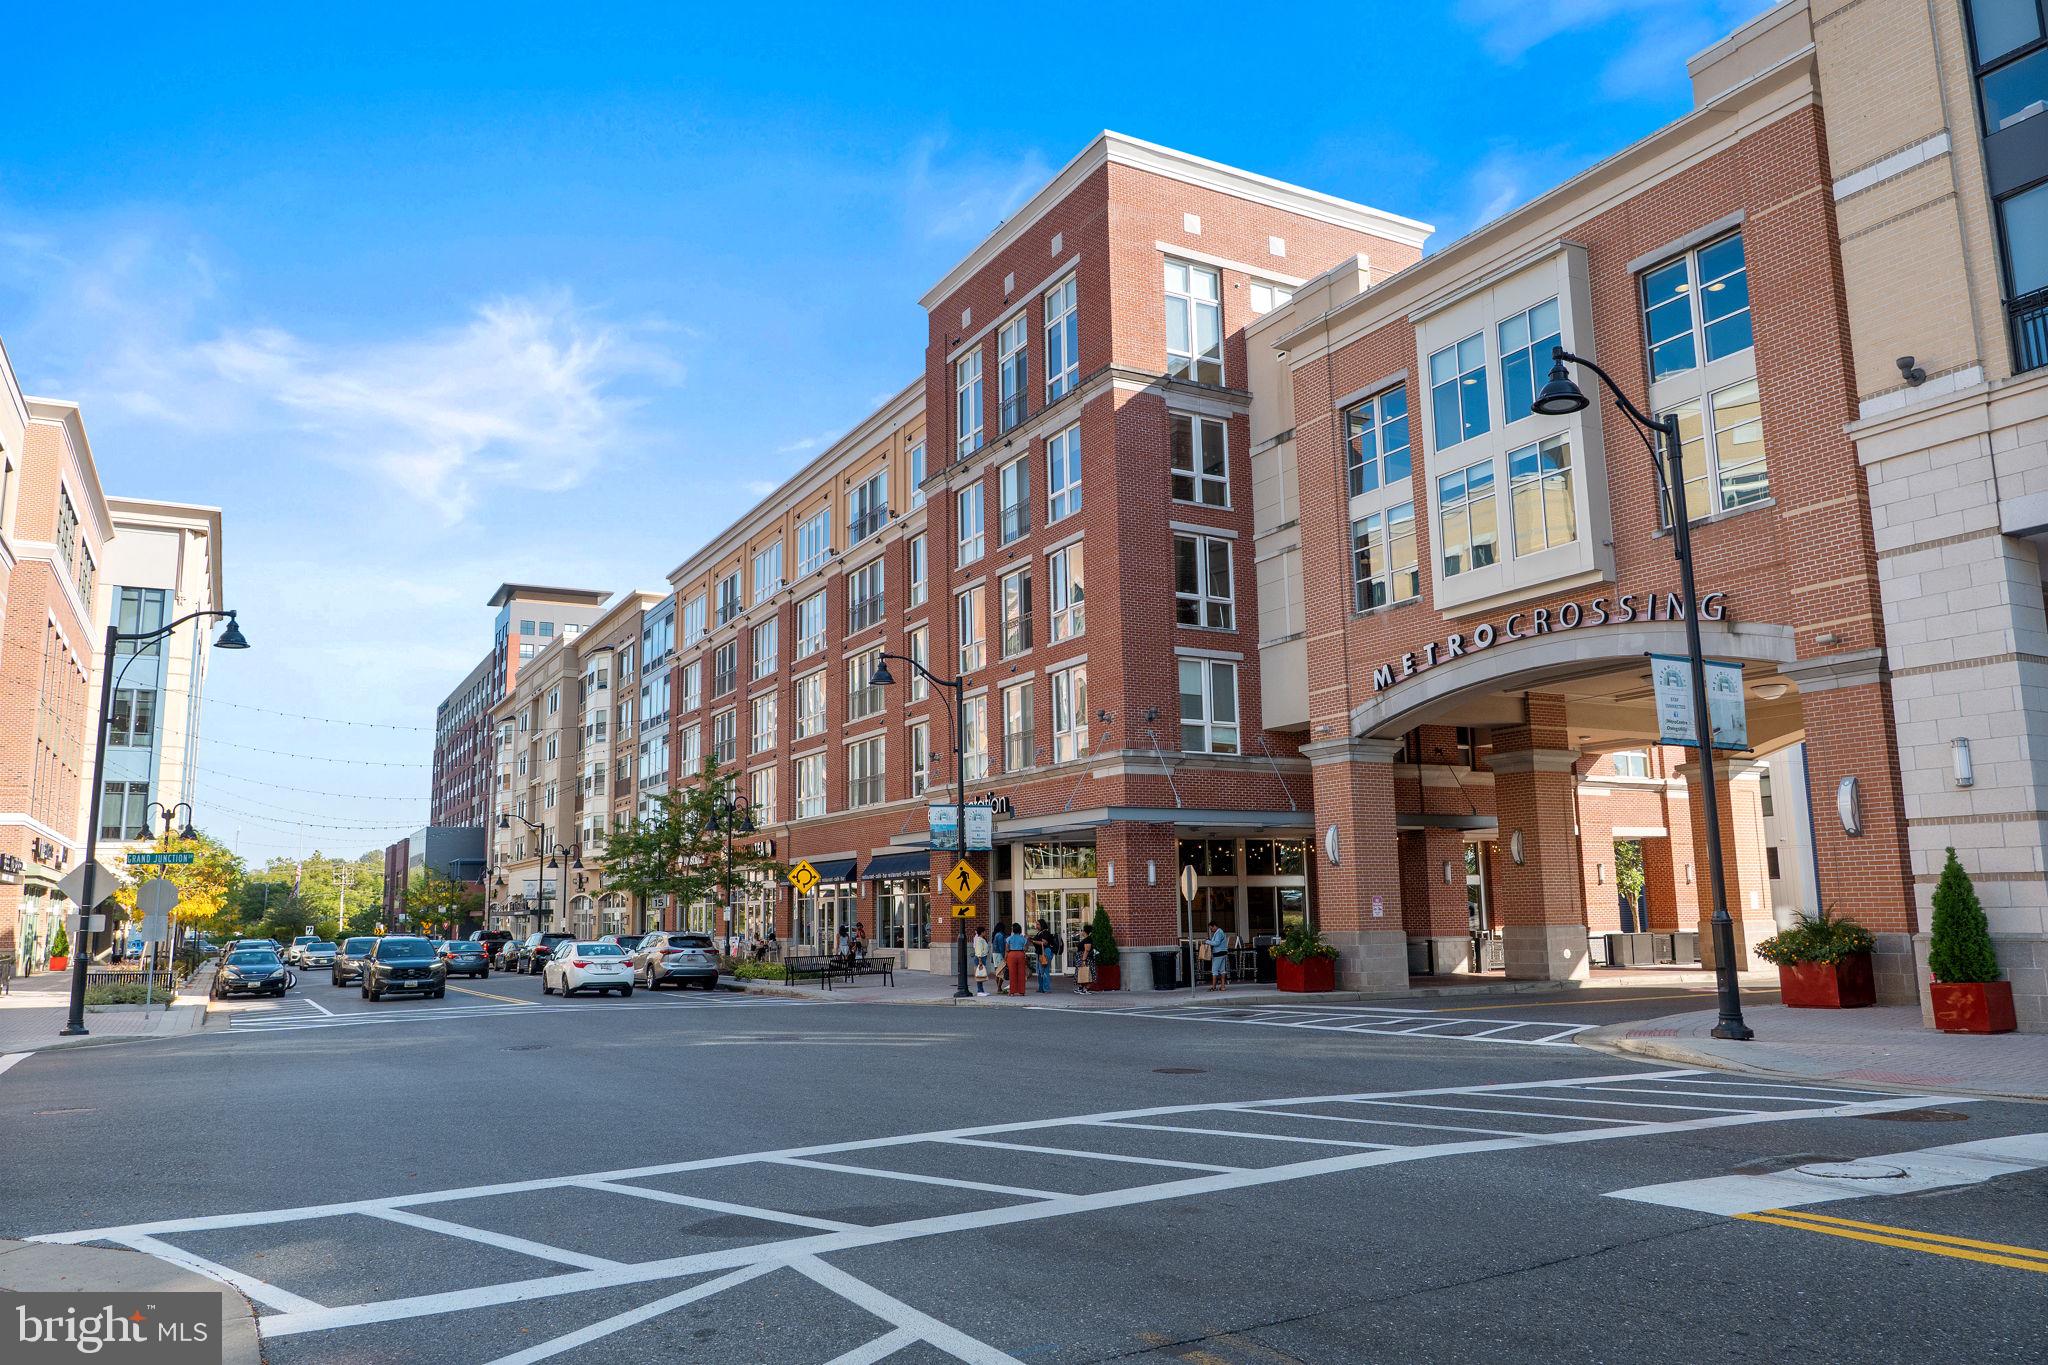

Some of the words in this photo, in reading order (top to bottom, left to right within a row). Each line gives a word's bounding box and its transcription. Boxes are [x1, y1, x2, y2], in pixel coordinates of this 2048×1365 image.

[1373, 592, 1728, 692] METROCROSSING
[127, 854, 151, 863] GRAND
[153, 853, 188, 863] JUNCTION
[654, 899, 664, 907] 15
